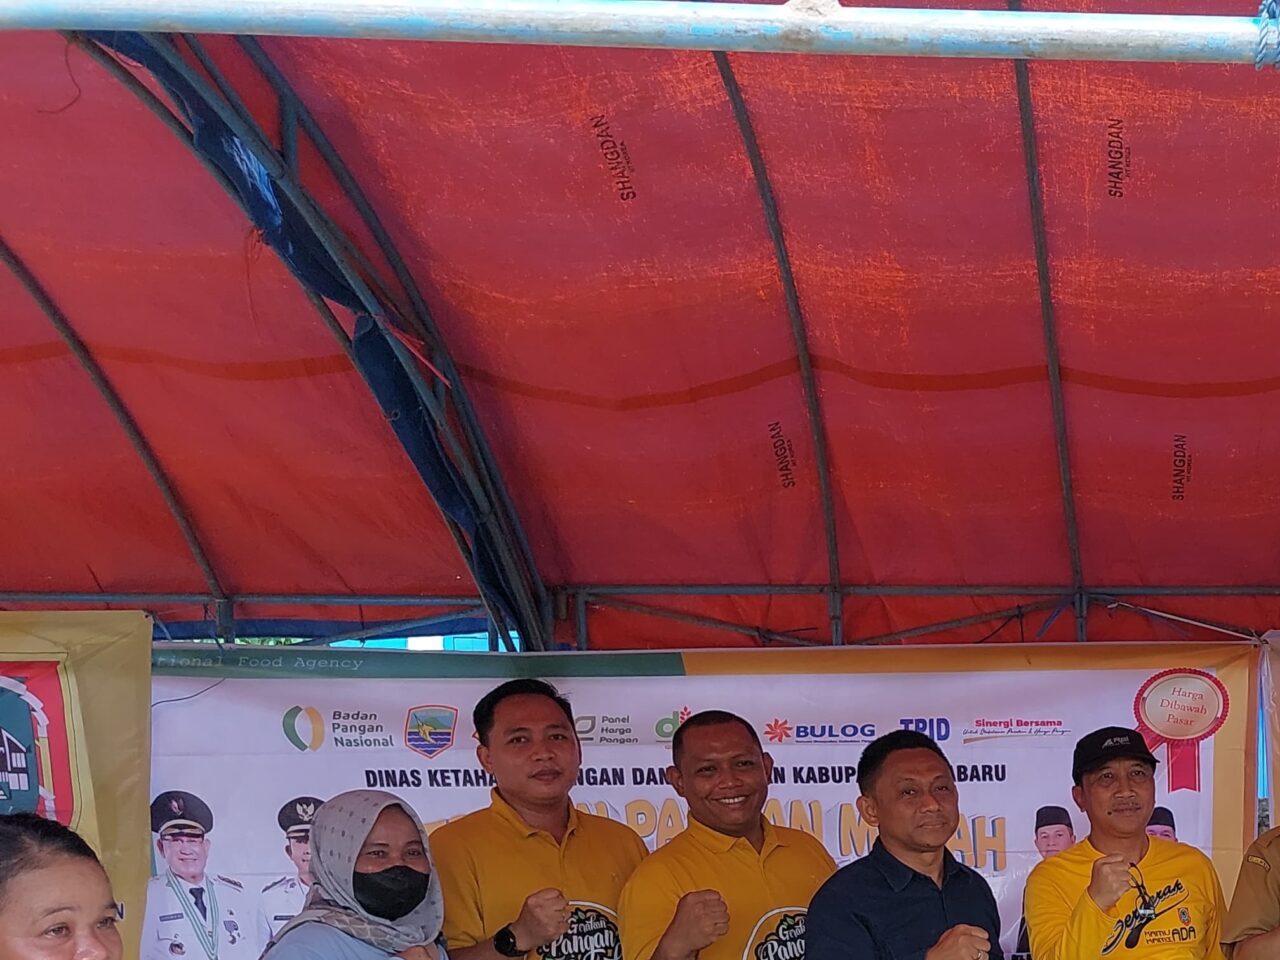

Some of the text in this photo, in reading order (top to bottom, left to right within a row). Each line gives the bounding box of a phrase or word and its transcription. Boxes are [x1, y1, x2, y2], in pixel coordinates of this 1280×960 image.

[590, 114, 637, 201] SHANGDAN
[1108, 118, 1124, 198] SHANGDAN
[767, 421, 796, 488] SHANGDAN
[1172, 434, 1187, 501] SHANGDAN
[238, 656, 283, 668] Food
[294, 656, 364, 671] Agency
[1171, 687, 1204, 701] Harga
[1160, 699, 1207, 715] Dibawah
[332, 710, 378, 721] Badan
[601, 715, 630, 725] Panel
[1167, 713, 1195, 727] Pasar
[331, 723, 384, 735] Pangan
[975, 718, 1063, 728] Sinergi Bersama
[601, 726, 632, 736] Harga
[796, 724, 876, 738] BULOG
[334, 736, 395, 748] Nasional
[599, 736, 639, 745] Pangan
[365, 769, 422, 788] DINAS
[1171, 926, 1197, 942] ADA
